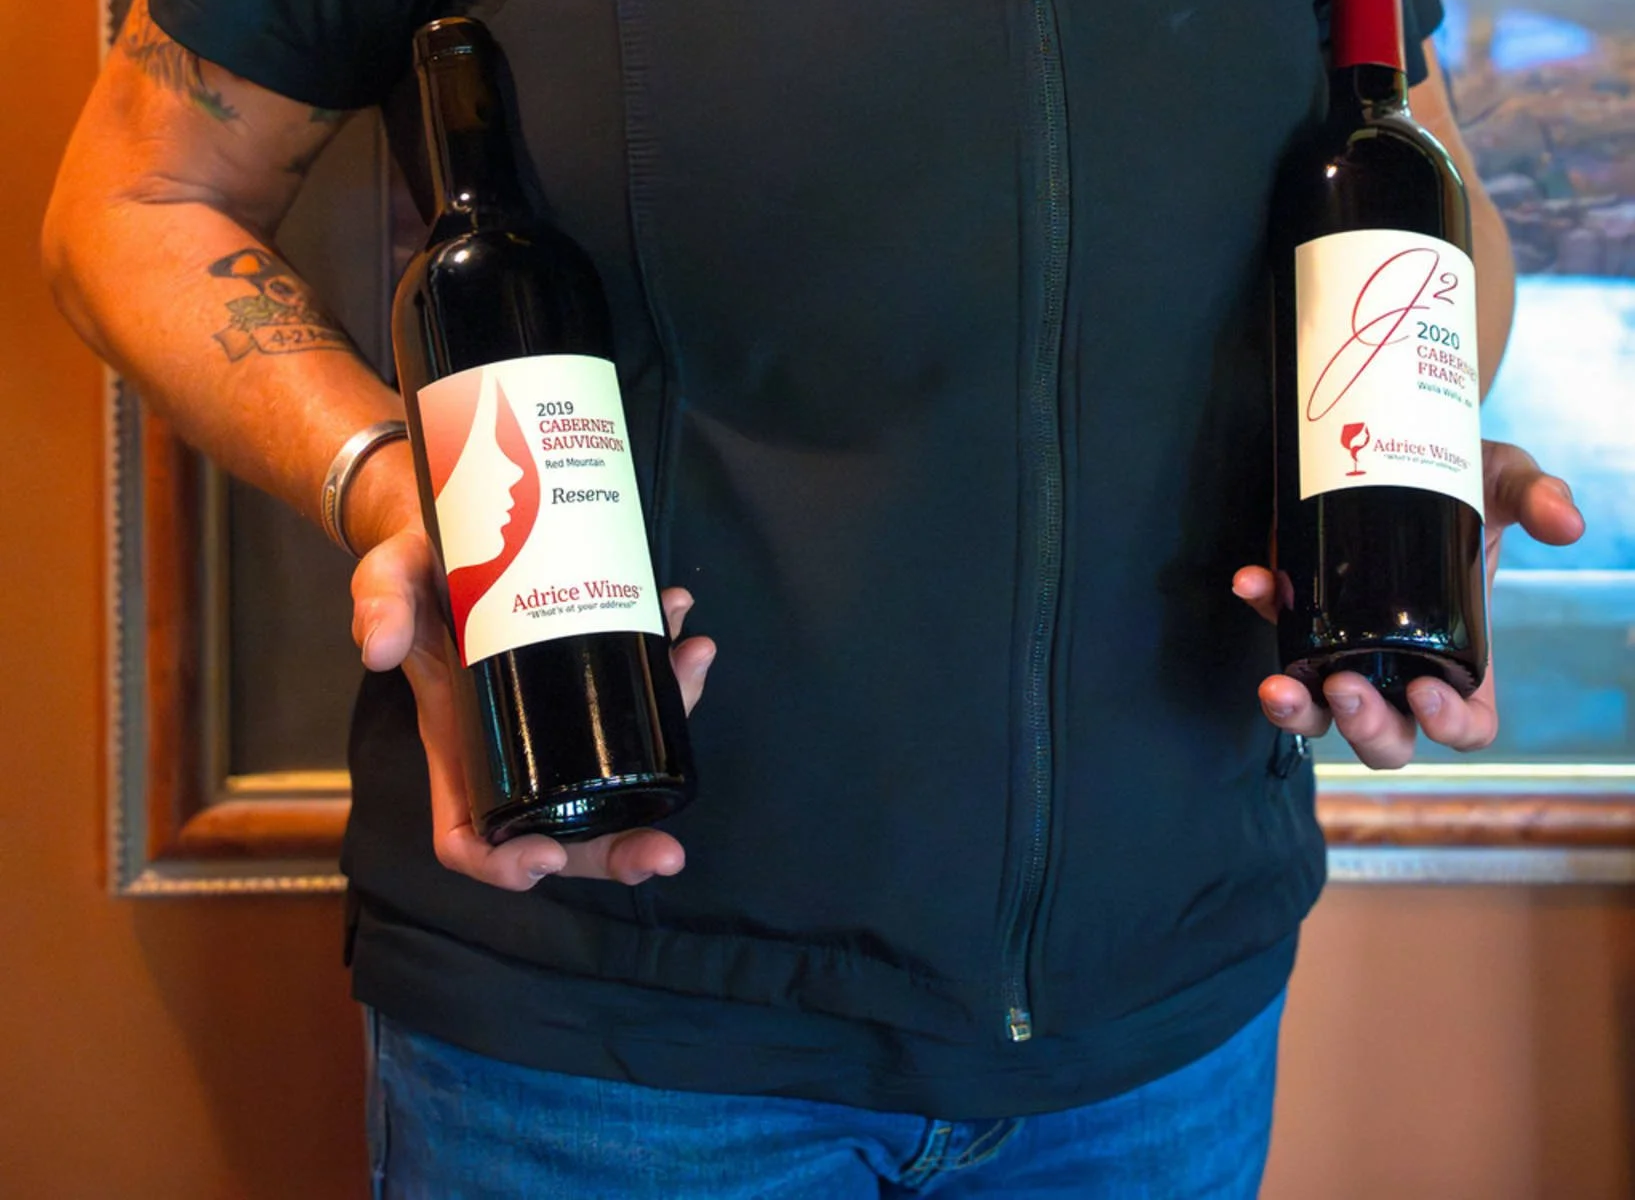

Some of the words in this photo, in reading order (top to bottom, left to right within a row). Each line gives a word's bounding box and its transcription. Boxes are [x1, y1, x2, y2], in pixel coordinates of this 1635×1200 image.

[1416, 321, 1460, 350] 2020
[1418, 361, 1465, 390] FRANC
[536, 401, 574, 417] 2019
[539, 417, 615, 435] CABERNET
[541, 435, 625, 453] SAUVIGNON
[1373, 438, 1427, 456] Adrice
[1429, 443, 1469, 470] Wines
[544, 458, 565, 470] Red
[565, 457, 606, 469] Mountain
[551, 487, 621, 505] Reserve
[512, 585, 581, 614] Adrice
